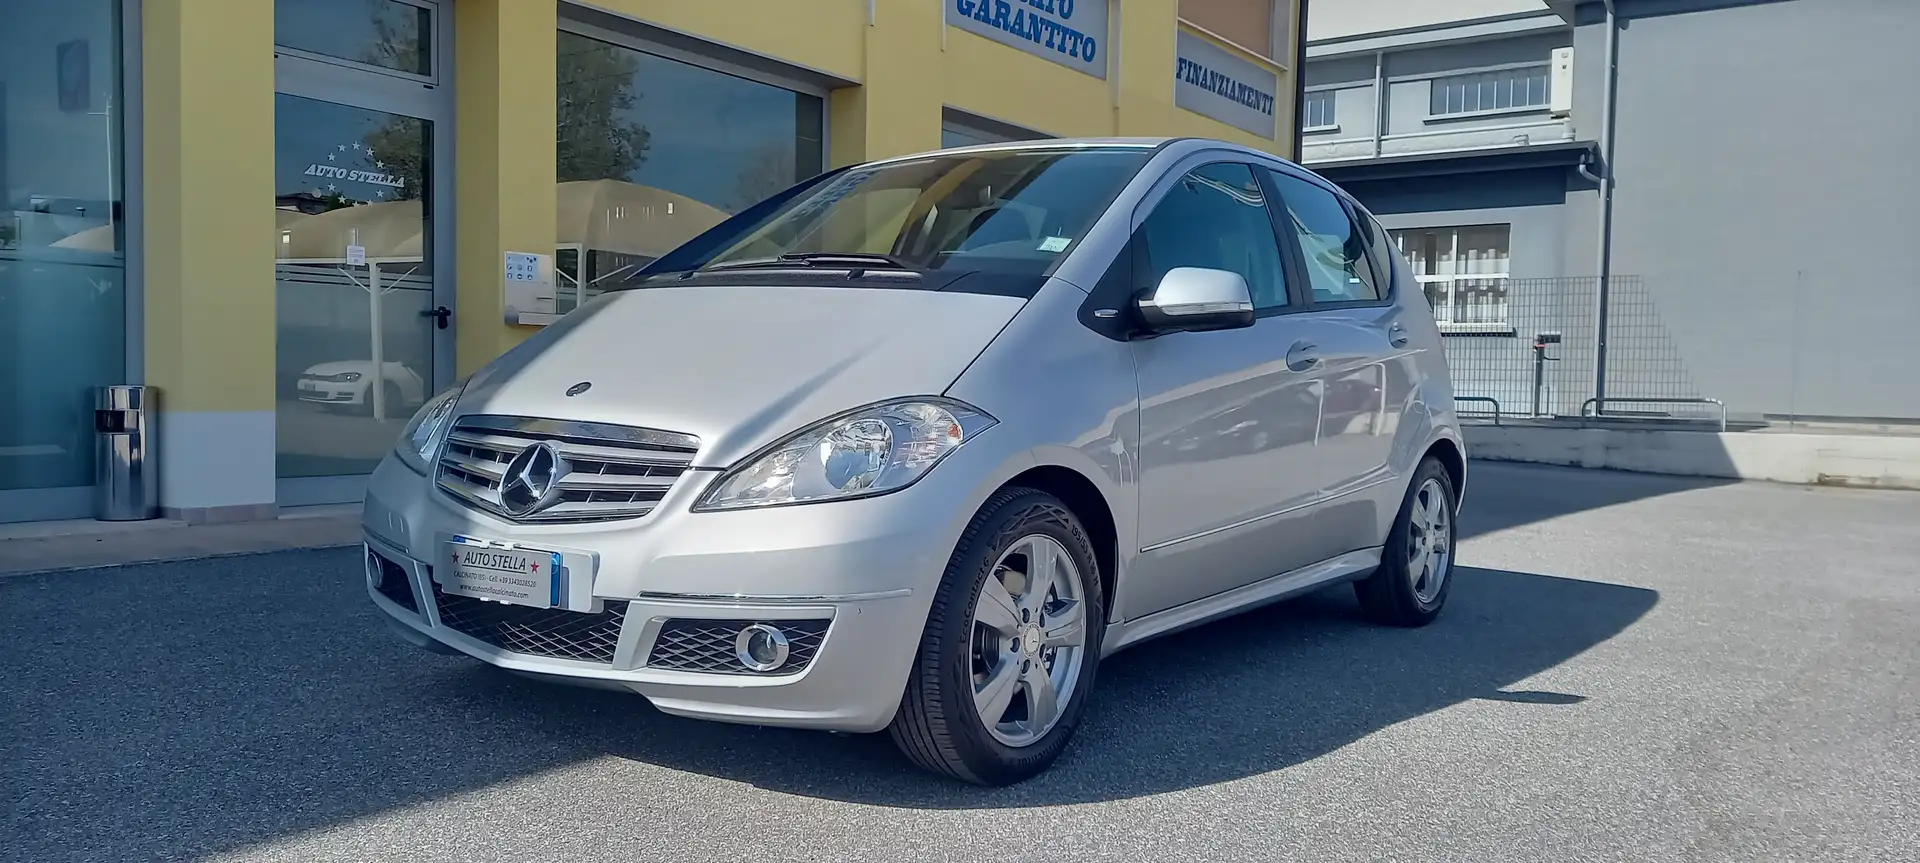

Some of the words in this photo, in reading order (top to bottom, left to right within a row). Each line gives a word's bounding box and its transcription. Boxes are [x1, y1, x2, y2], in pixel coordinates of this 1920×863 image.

[957, 0, 1096, 62] GARANTITO
[1176, 57, 1274, 116] FINANZIAMENTI
[304, 163, 348, 180] AUTO
[347, 169, 405, 188] STELLA
[453, 570, 478, 580] CALCINATO
[463, 551, 490, 566] AUTO
[491, 554, 526, 571] STELLA
[960, 566, 985, 643] EcoContact
